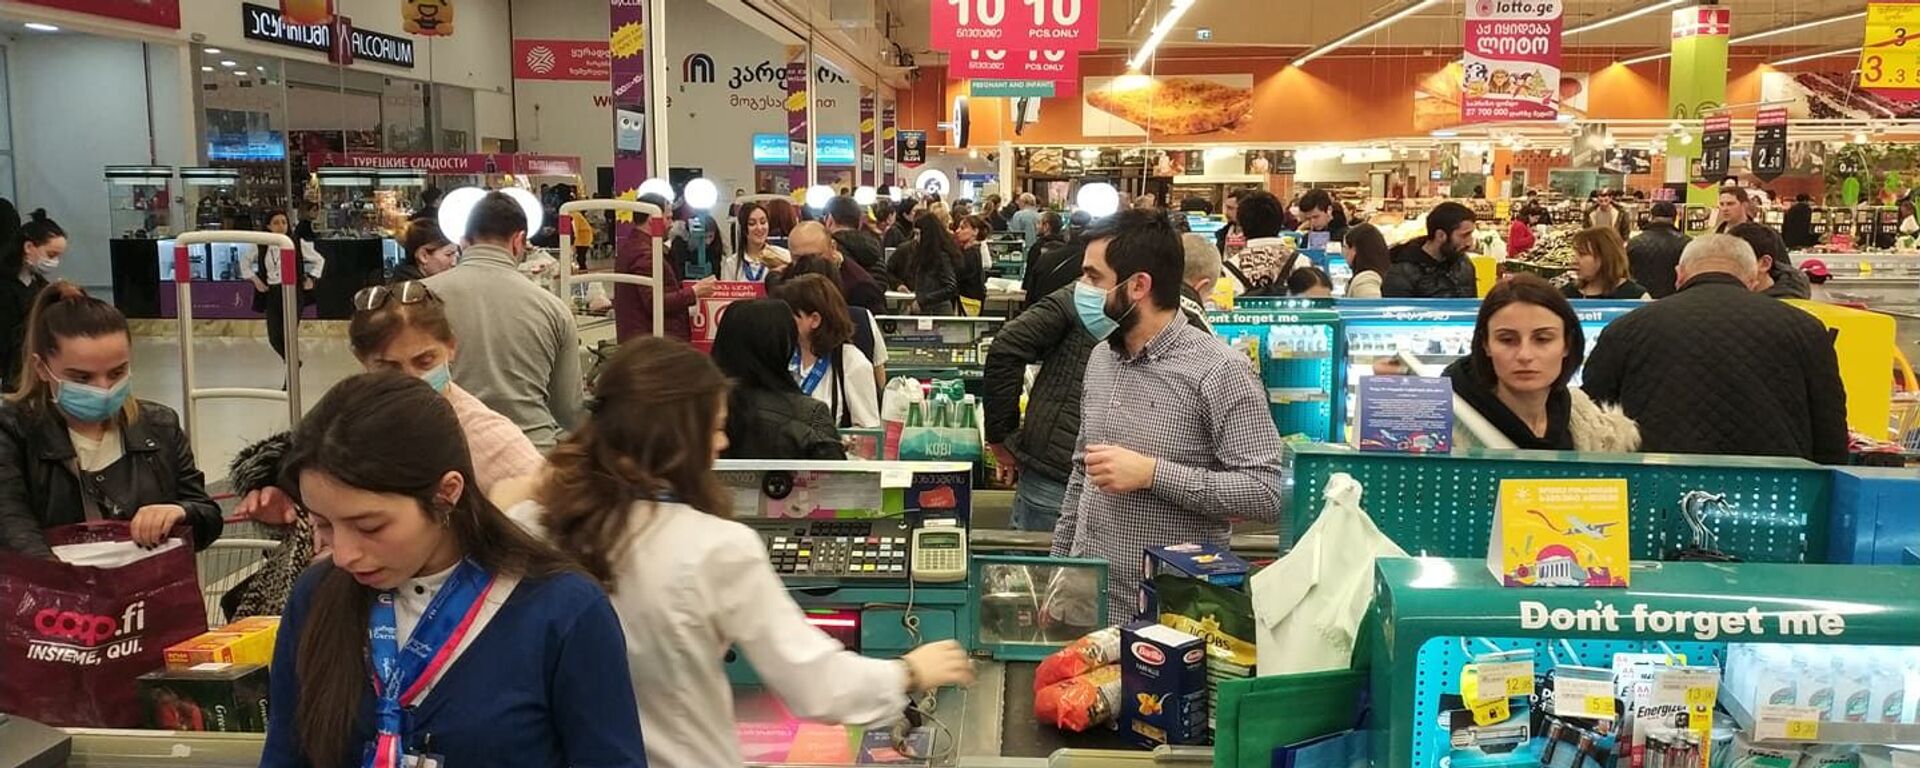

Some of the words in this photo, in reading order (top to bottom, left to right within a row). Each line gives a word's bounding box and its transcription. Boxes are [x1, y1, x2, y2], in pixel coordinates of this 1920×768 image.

[1496, 0, 1553, 16] lotto.ge
[352, 32, 413, 63] ALCORIUM
[1477, 37, 1549, 54] ლოტო
[353, 157, 408, 169] ТУРЕЦКИЕ
[410, 157, 469, 170] СЛАДОСТИ
[1233, 313, 1274, 324] forget
[1278, 314, 1299, 323] me
[1577, 311, 1602, 321] self
[1520, 600, 1619, 632] Don't
[1633, 603, 1763, 640] forget
[1778, 612, 1845, 635] me
[27, 644, 101, 665] INSIEME,
[107, 639, 143, 659] QUI.
